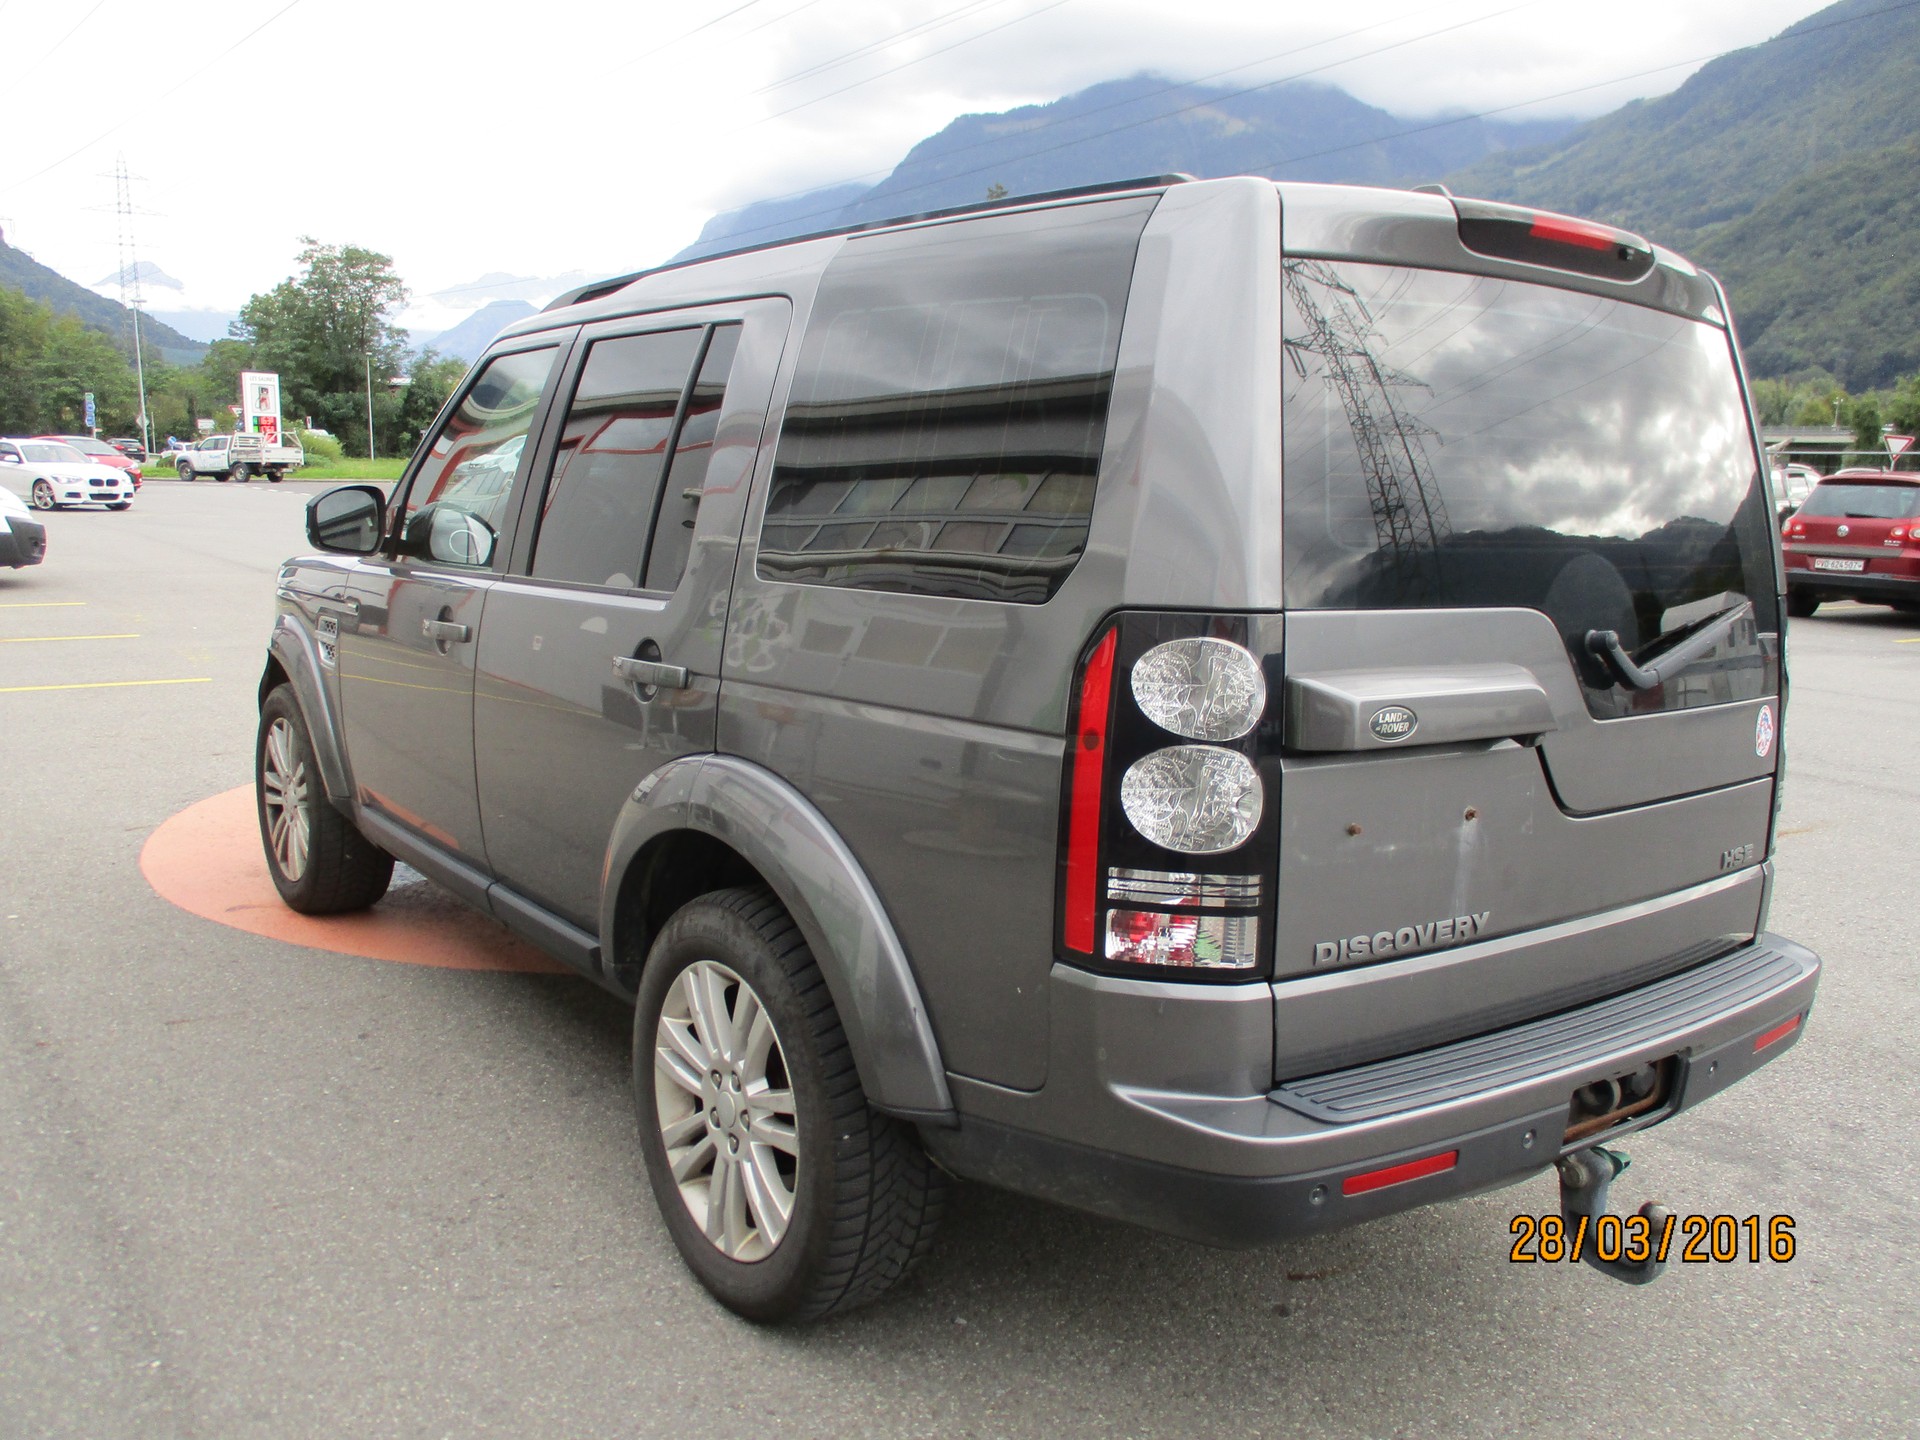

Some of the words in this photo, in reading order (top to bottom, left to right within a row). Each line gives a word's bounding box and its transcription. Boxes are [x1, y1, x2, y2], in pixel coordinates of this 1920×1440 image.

[1379, 712, 1402, 724] LAND
[1380, 721, 1410, 733] ROVER
[1721, 843, 1754, 869] HSE
[1313, 911, 1490, 966] DISCOVERY
